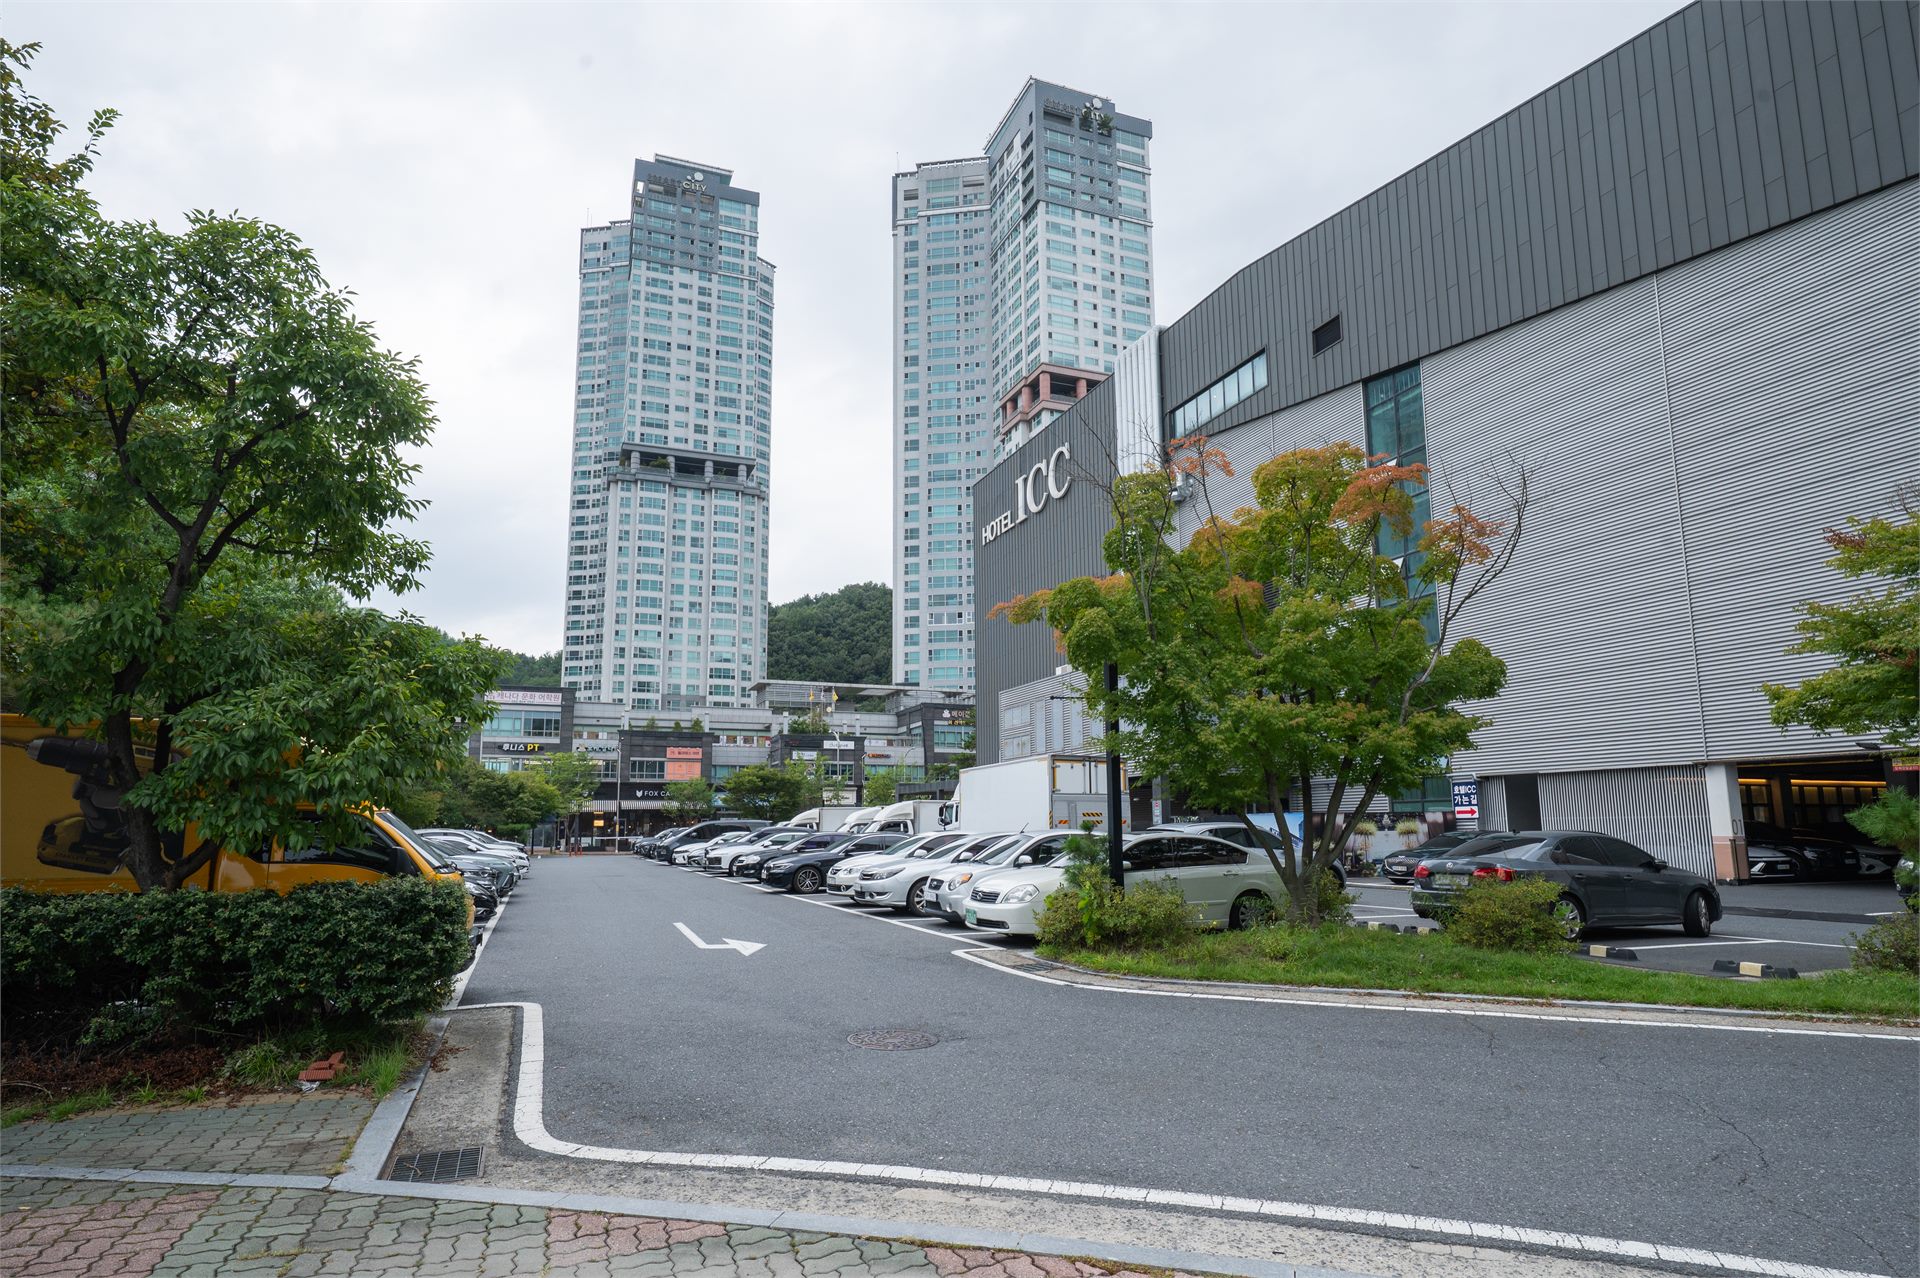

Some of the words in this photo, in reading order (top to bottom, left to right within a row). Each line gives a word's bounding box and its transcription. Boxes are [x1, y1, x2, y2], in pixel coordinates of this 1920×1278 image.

[682, 181, 707, 192] CITY
[982, 510, 1015, 546] HOTEL
[1015, 442, 1073, 524] ICC
[527, 743, 540, 752] PT
[1731, 819, 1744, 835] 01
